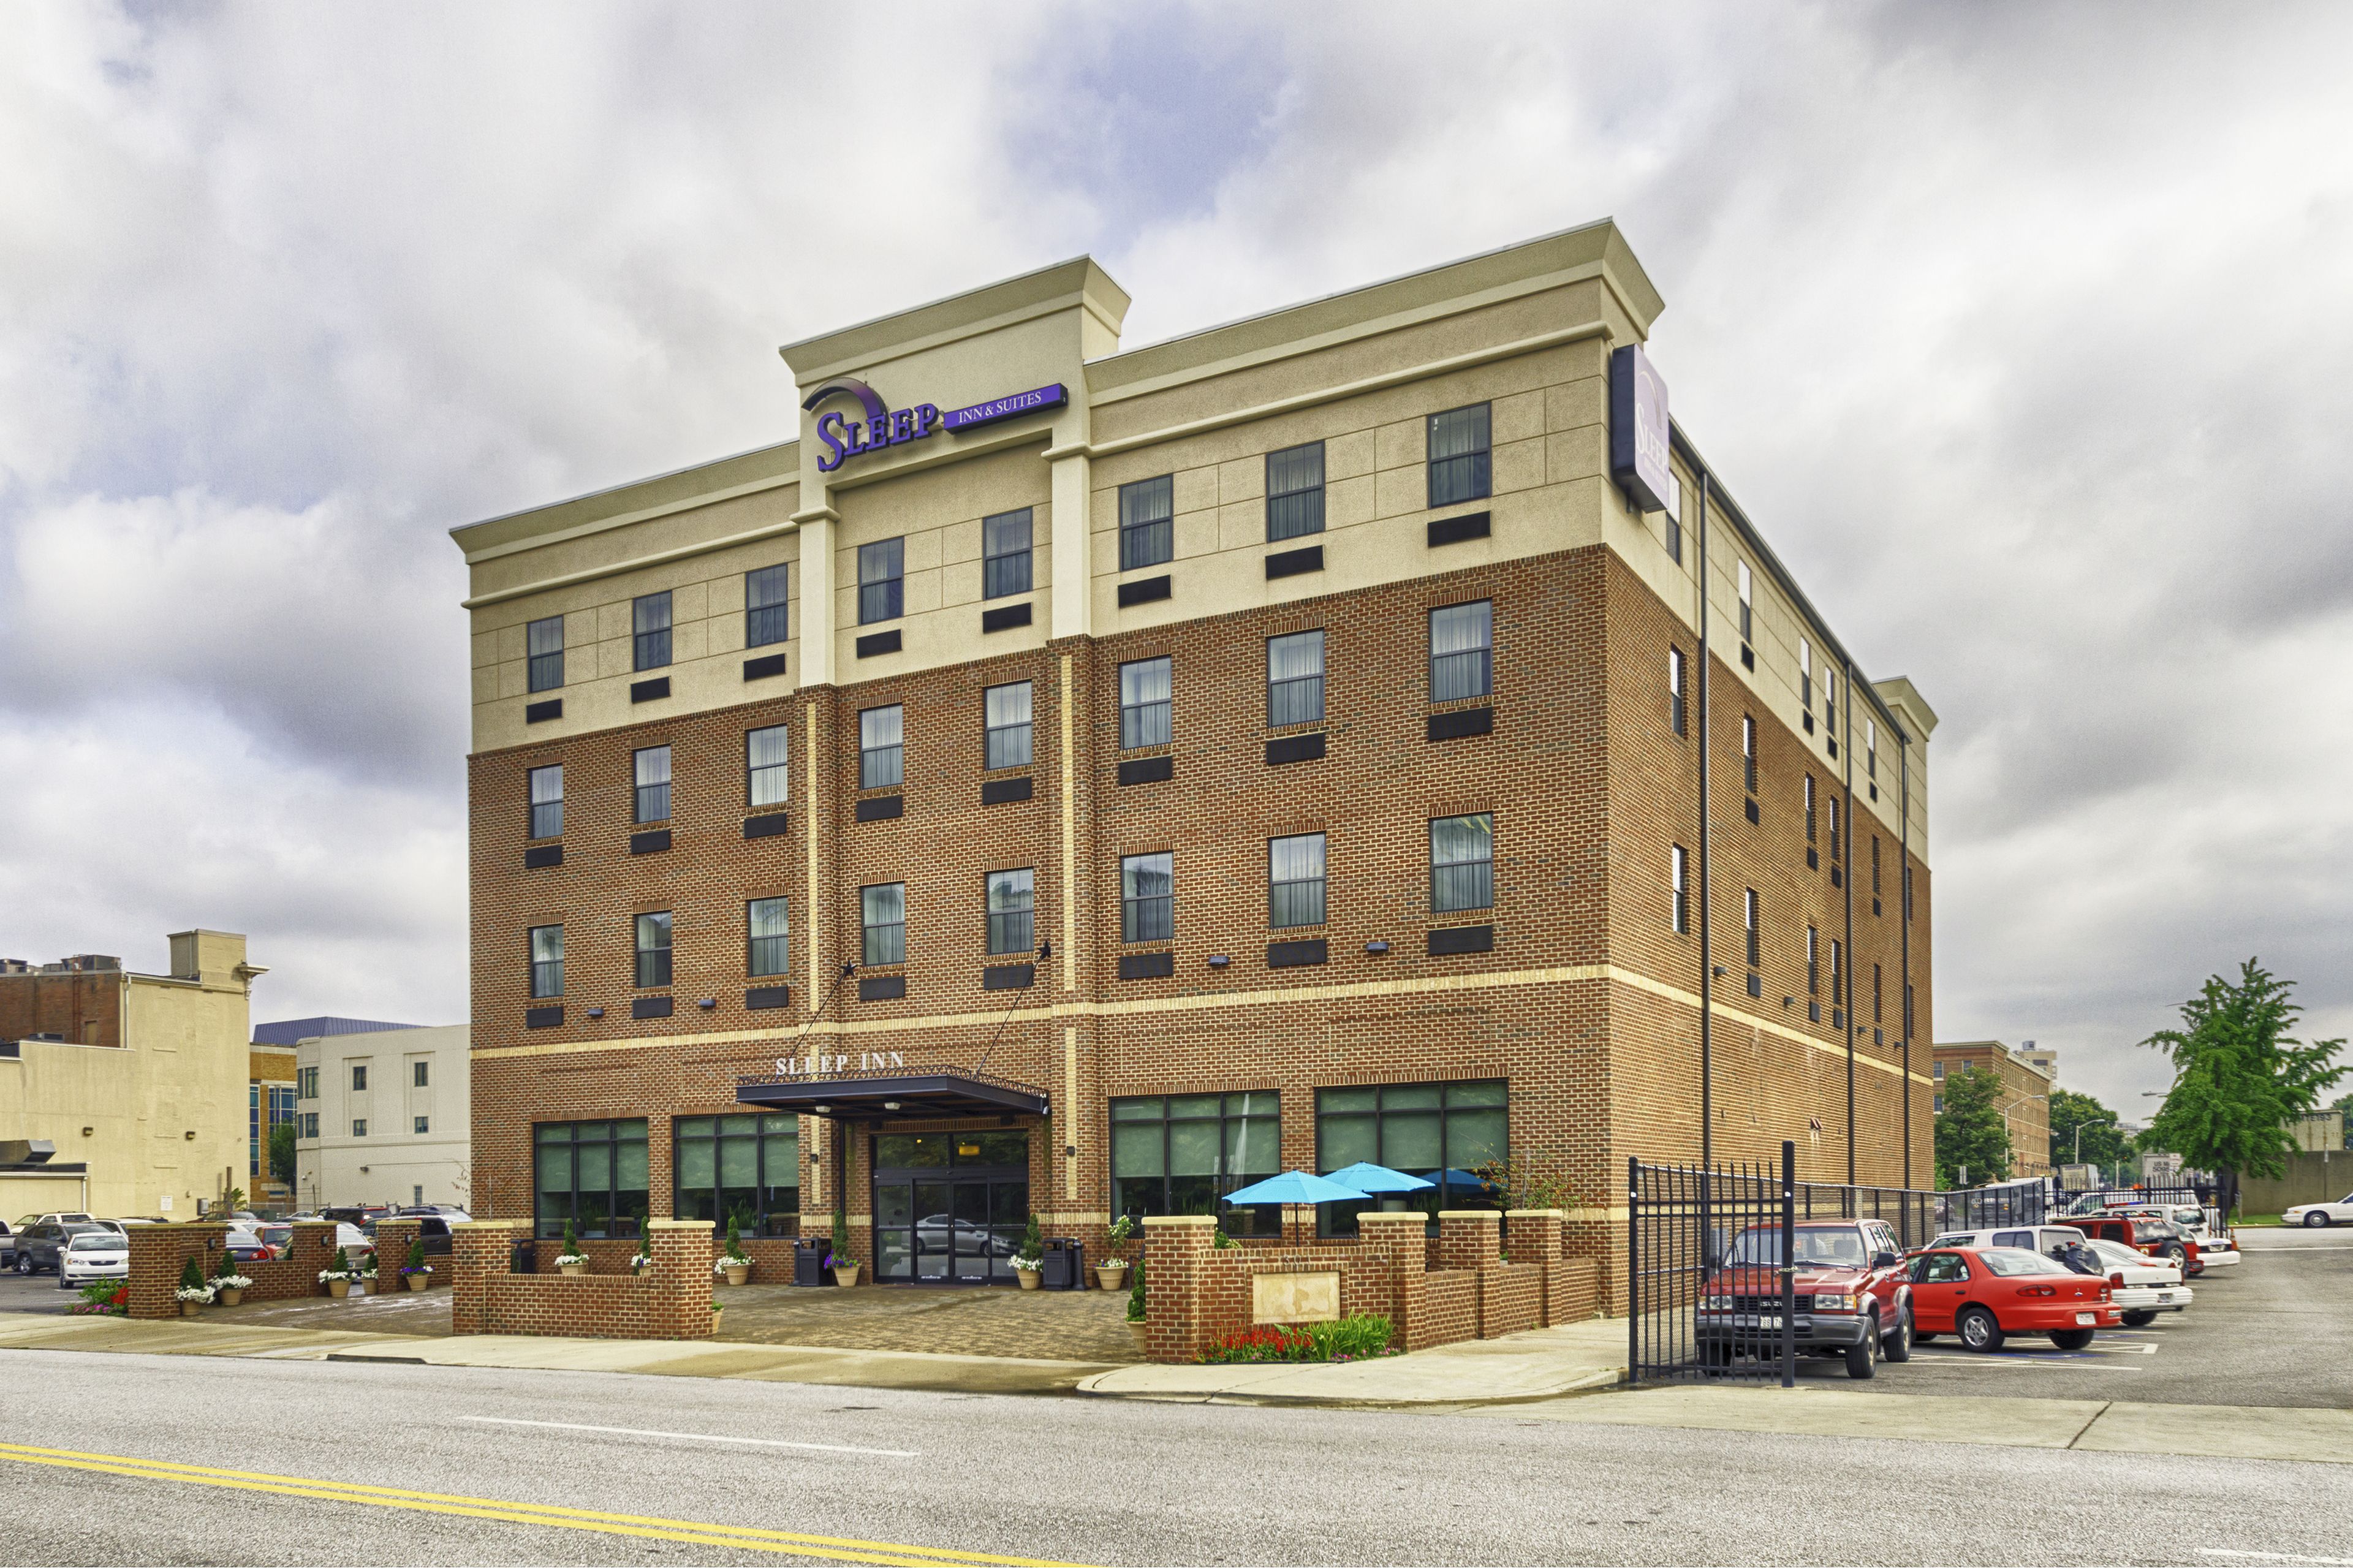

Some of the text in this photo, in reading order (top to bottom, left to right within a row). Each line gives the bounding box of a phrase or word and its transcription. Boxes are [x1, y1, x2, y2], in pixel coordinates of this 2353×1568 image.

[817, 392, 1042, 472] SLEEP INN & SUITES
[1636, 402, 1668, 476] SLEEP
[861, 1051, 904, 1071] INN
